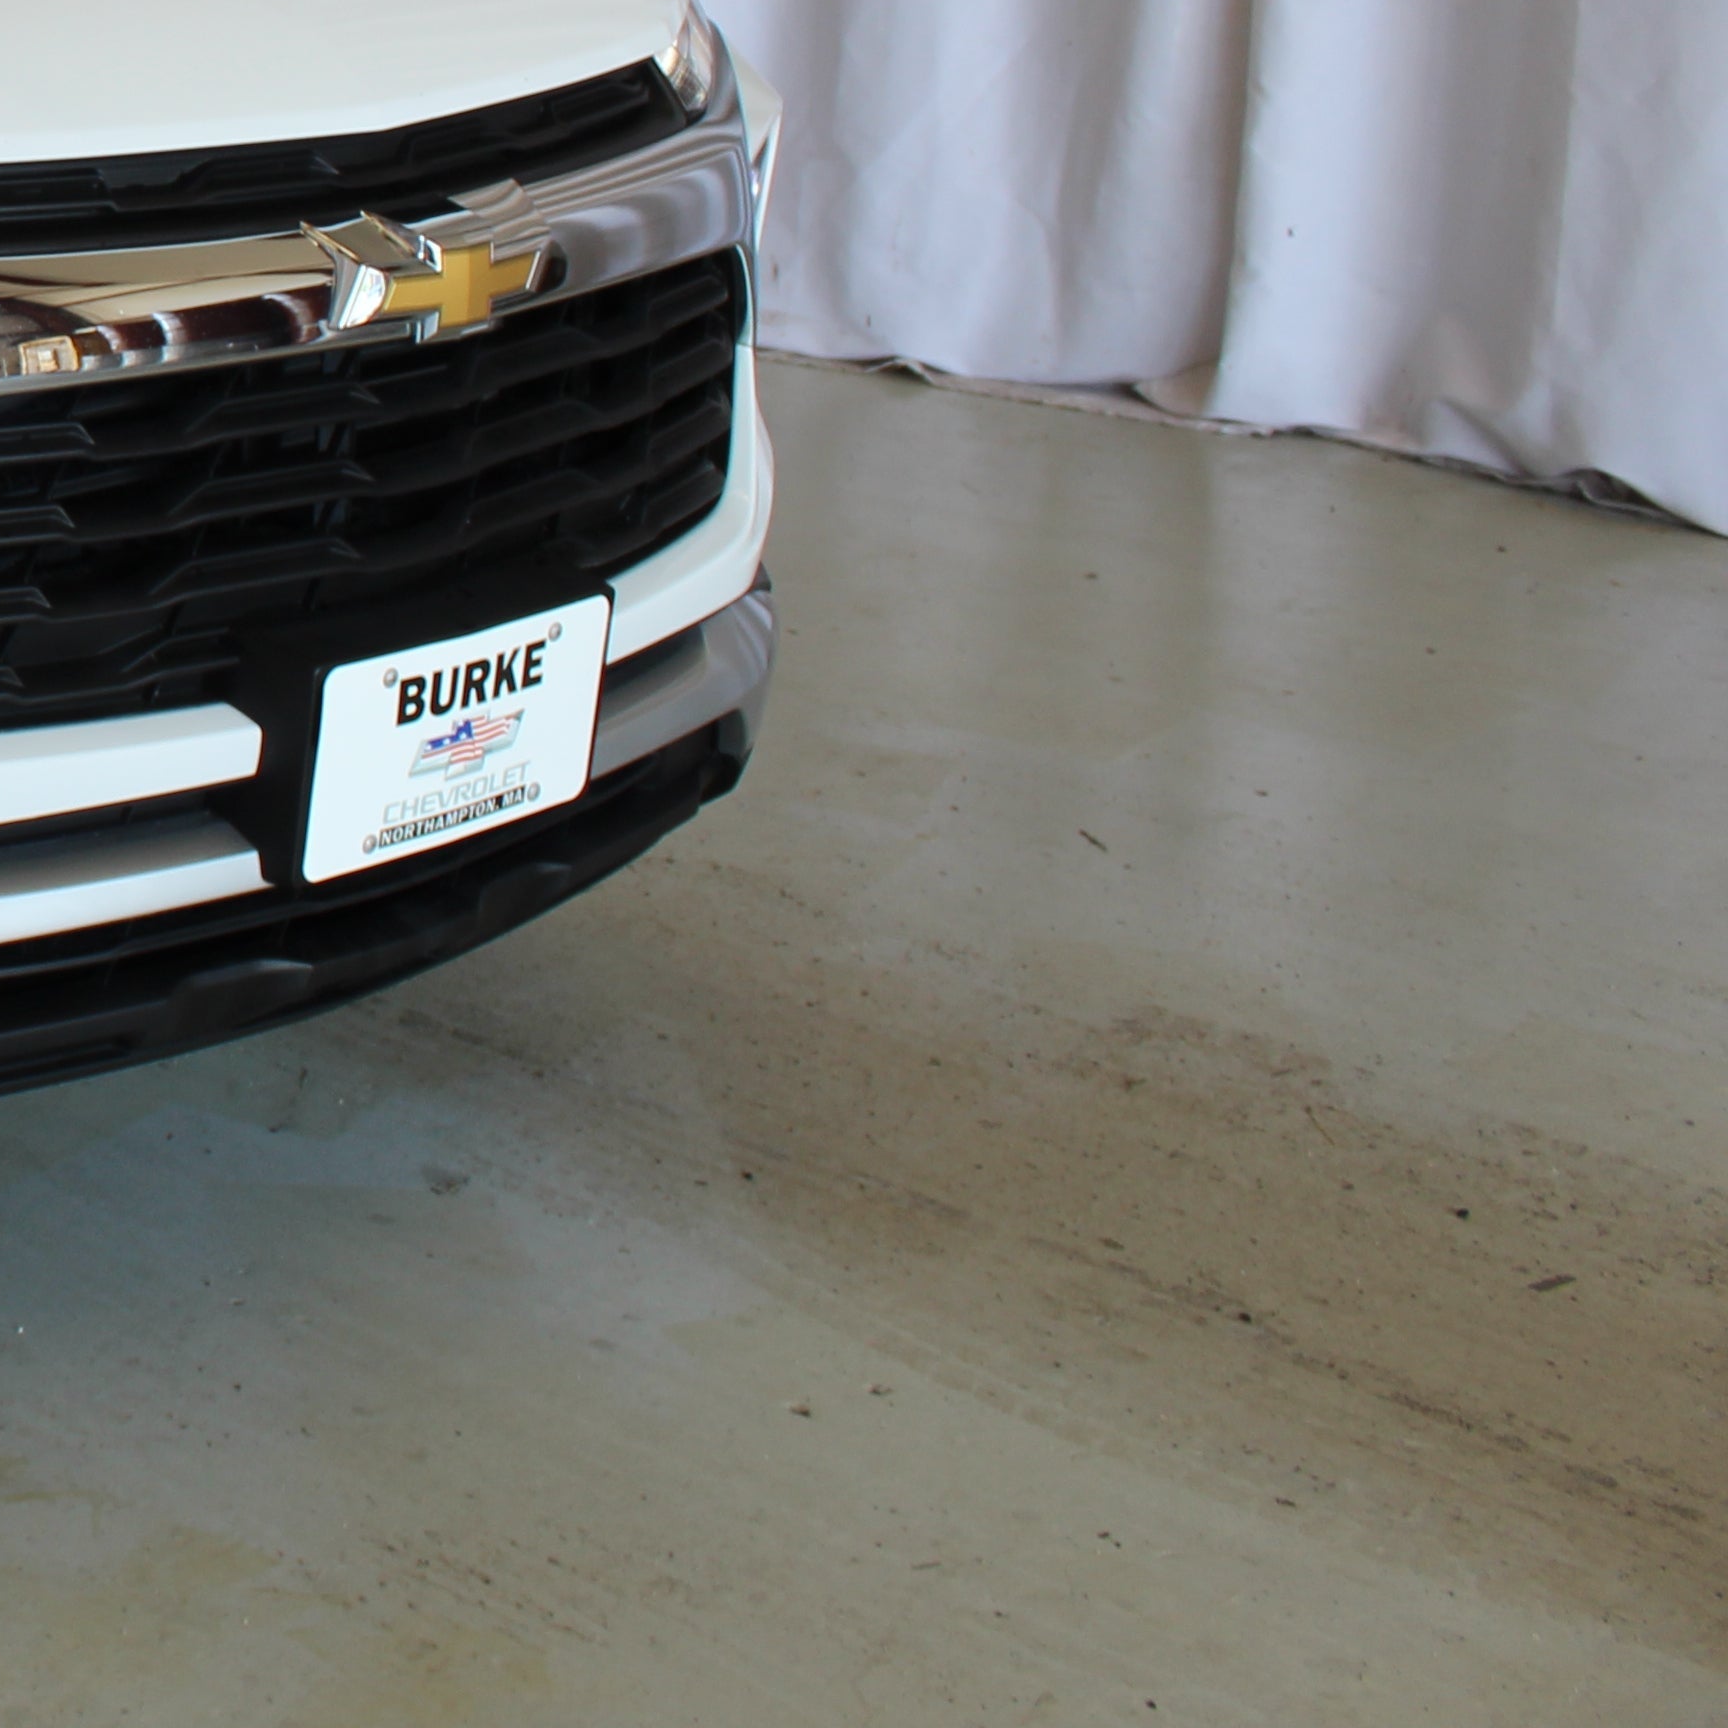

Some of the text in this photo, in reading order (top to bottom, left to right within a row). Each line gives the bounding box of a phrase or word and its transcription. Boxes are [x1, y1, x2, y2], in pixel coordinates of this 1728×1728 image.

[396, 638, 547, 726] BURKE
[382, 761, 531, 824] CHEVROLET
[502, 787, 523, 808] MA
